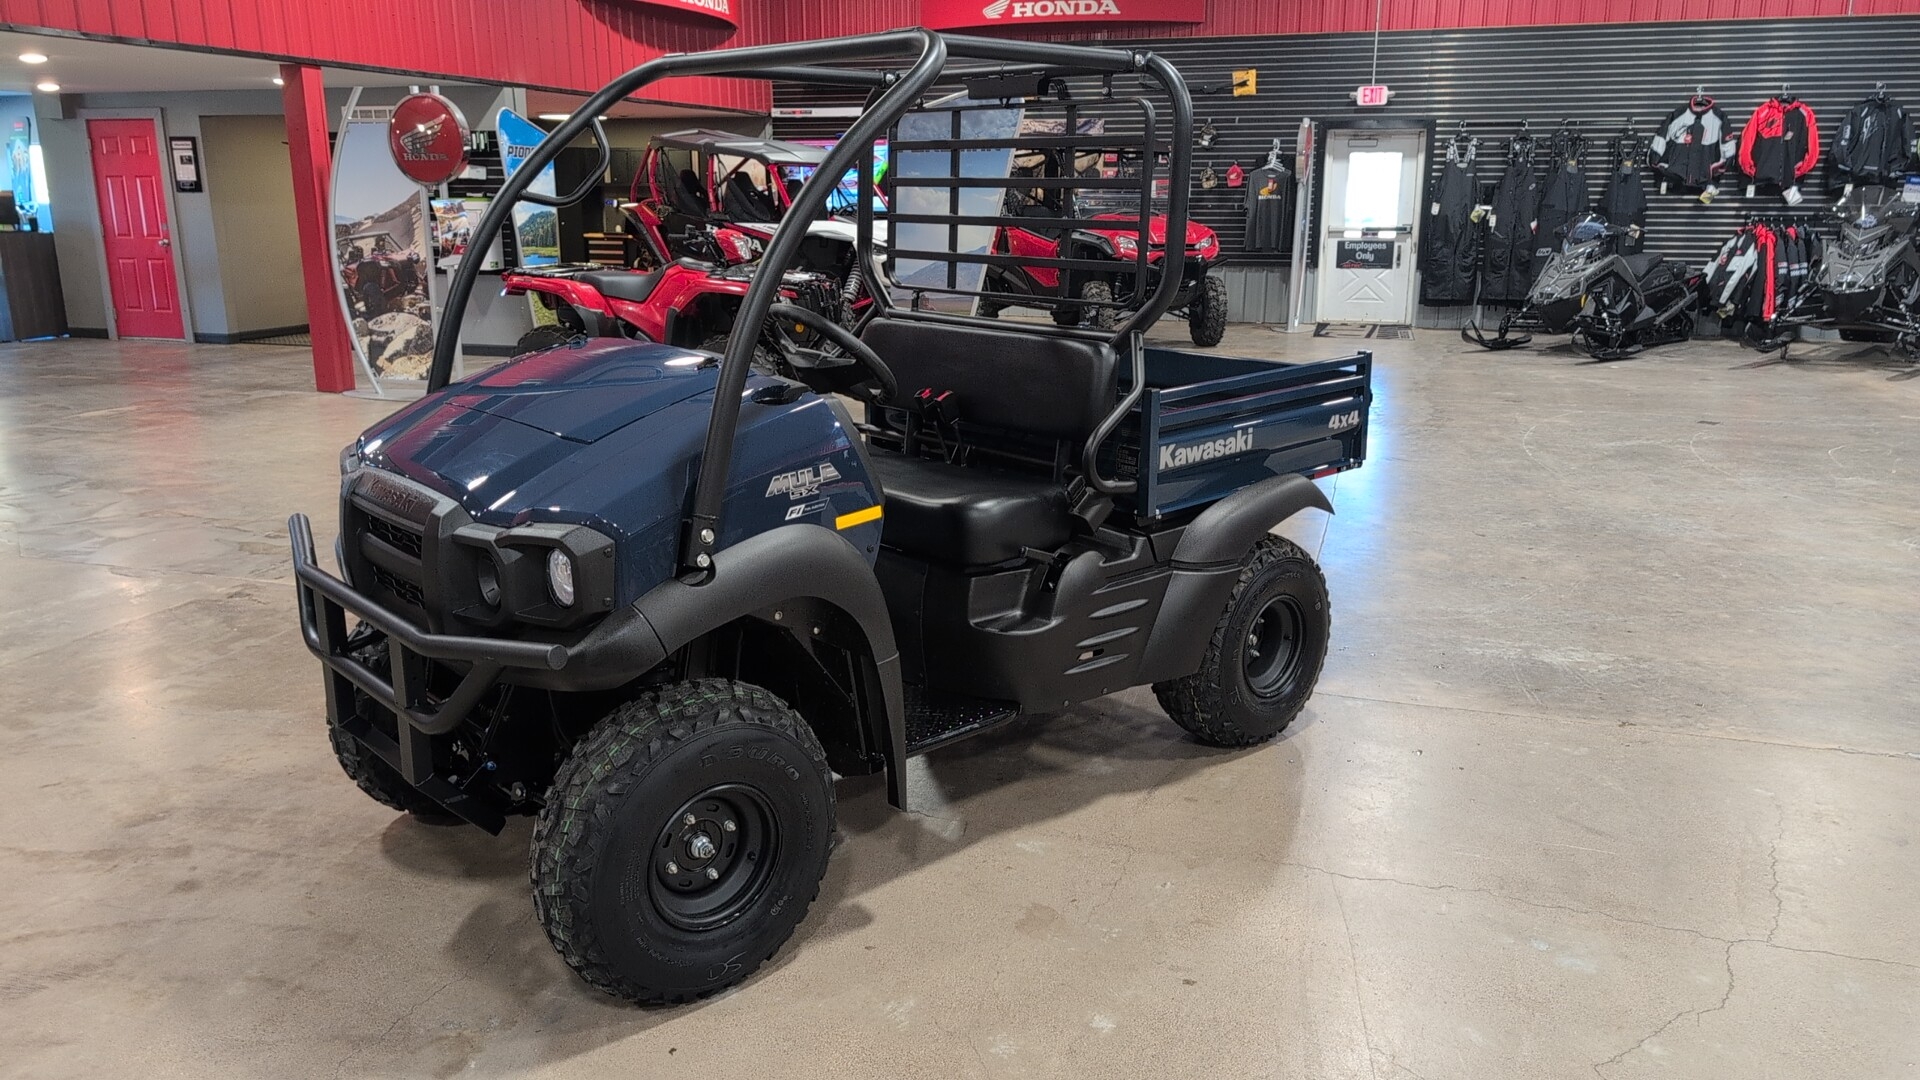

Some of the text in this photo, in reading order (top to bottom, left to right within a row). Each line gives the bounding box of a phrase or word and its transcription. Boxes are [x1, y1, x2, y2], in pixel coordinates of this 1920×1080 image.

[679, 0, 730, 15] ONDA
[1012, 0, 1121, 18] HONDA
[1362, 87, 1384, 104] EXIT
[402, 152, 450, 162] HONDA
[507, 145, 536, 158] PION
[1344, 241, 1388, 251] Employees
[1355, 251, 1375, 262] Only
[1328, 410, 1360, 430] 4x4
[1158, 427, 1254, 471] Kawasaki
[765, 462, 842, 498] MULE
[790, 484, 820, 500] SX
